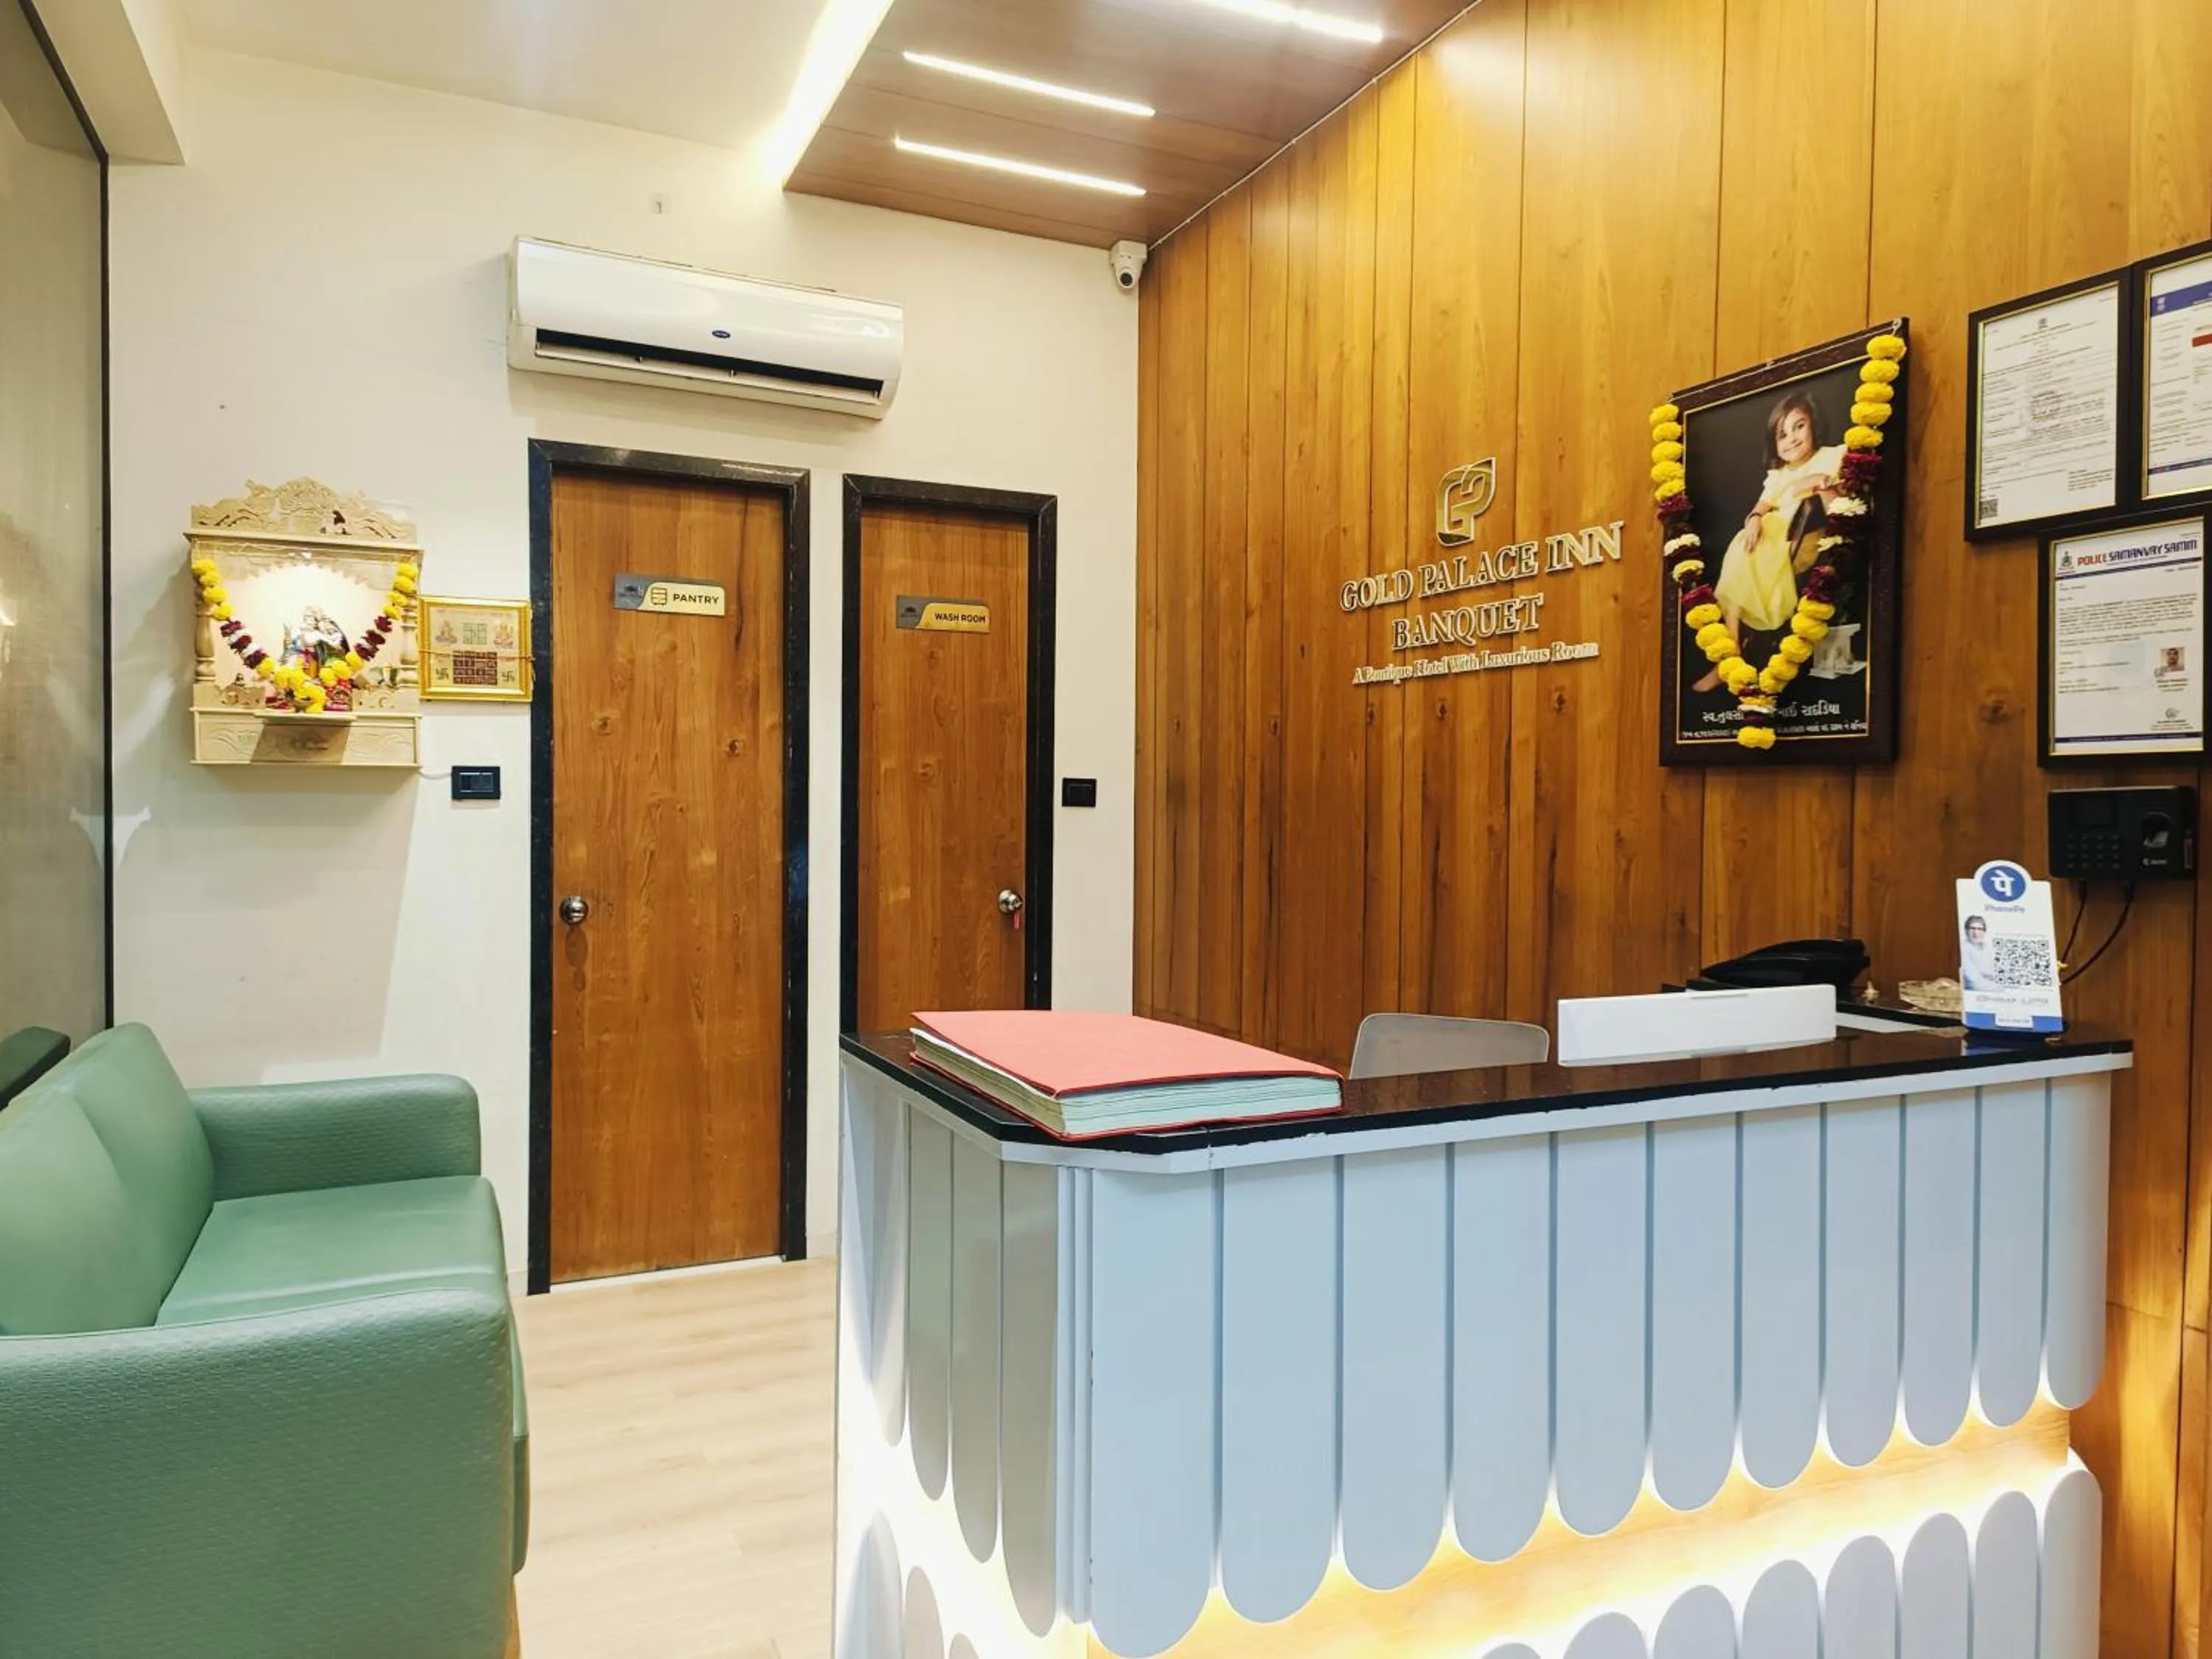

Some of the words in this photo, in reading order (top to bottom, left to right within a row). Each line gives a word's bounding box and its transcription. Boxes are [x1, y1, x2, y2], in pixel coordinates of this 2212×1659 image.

[1340, 569, 1413, 613] GOLD
[1417, 540, 1538, 599] PALACE
[1544, 521, 1624, 573] INN
[2076, 553, 2107, 567] POLICE
[2108, 542, 2163, 562] SAMANVAY
[673, 593, 719, 605] PANTRY
[935, 613, 959, 622] WASH
[961, 614, 986, 623] ROOM
[1391, 592, 1544, 651] BANQUET
[1413, 658, 1449, 677] Hotel
[1447, 653, 1480, 673] With
[1480, 644, 1551, 669] Luxurious
[1551, 641, 1599, 661] Room
[1991, 870, 2014, 897] पे
